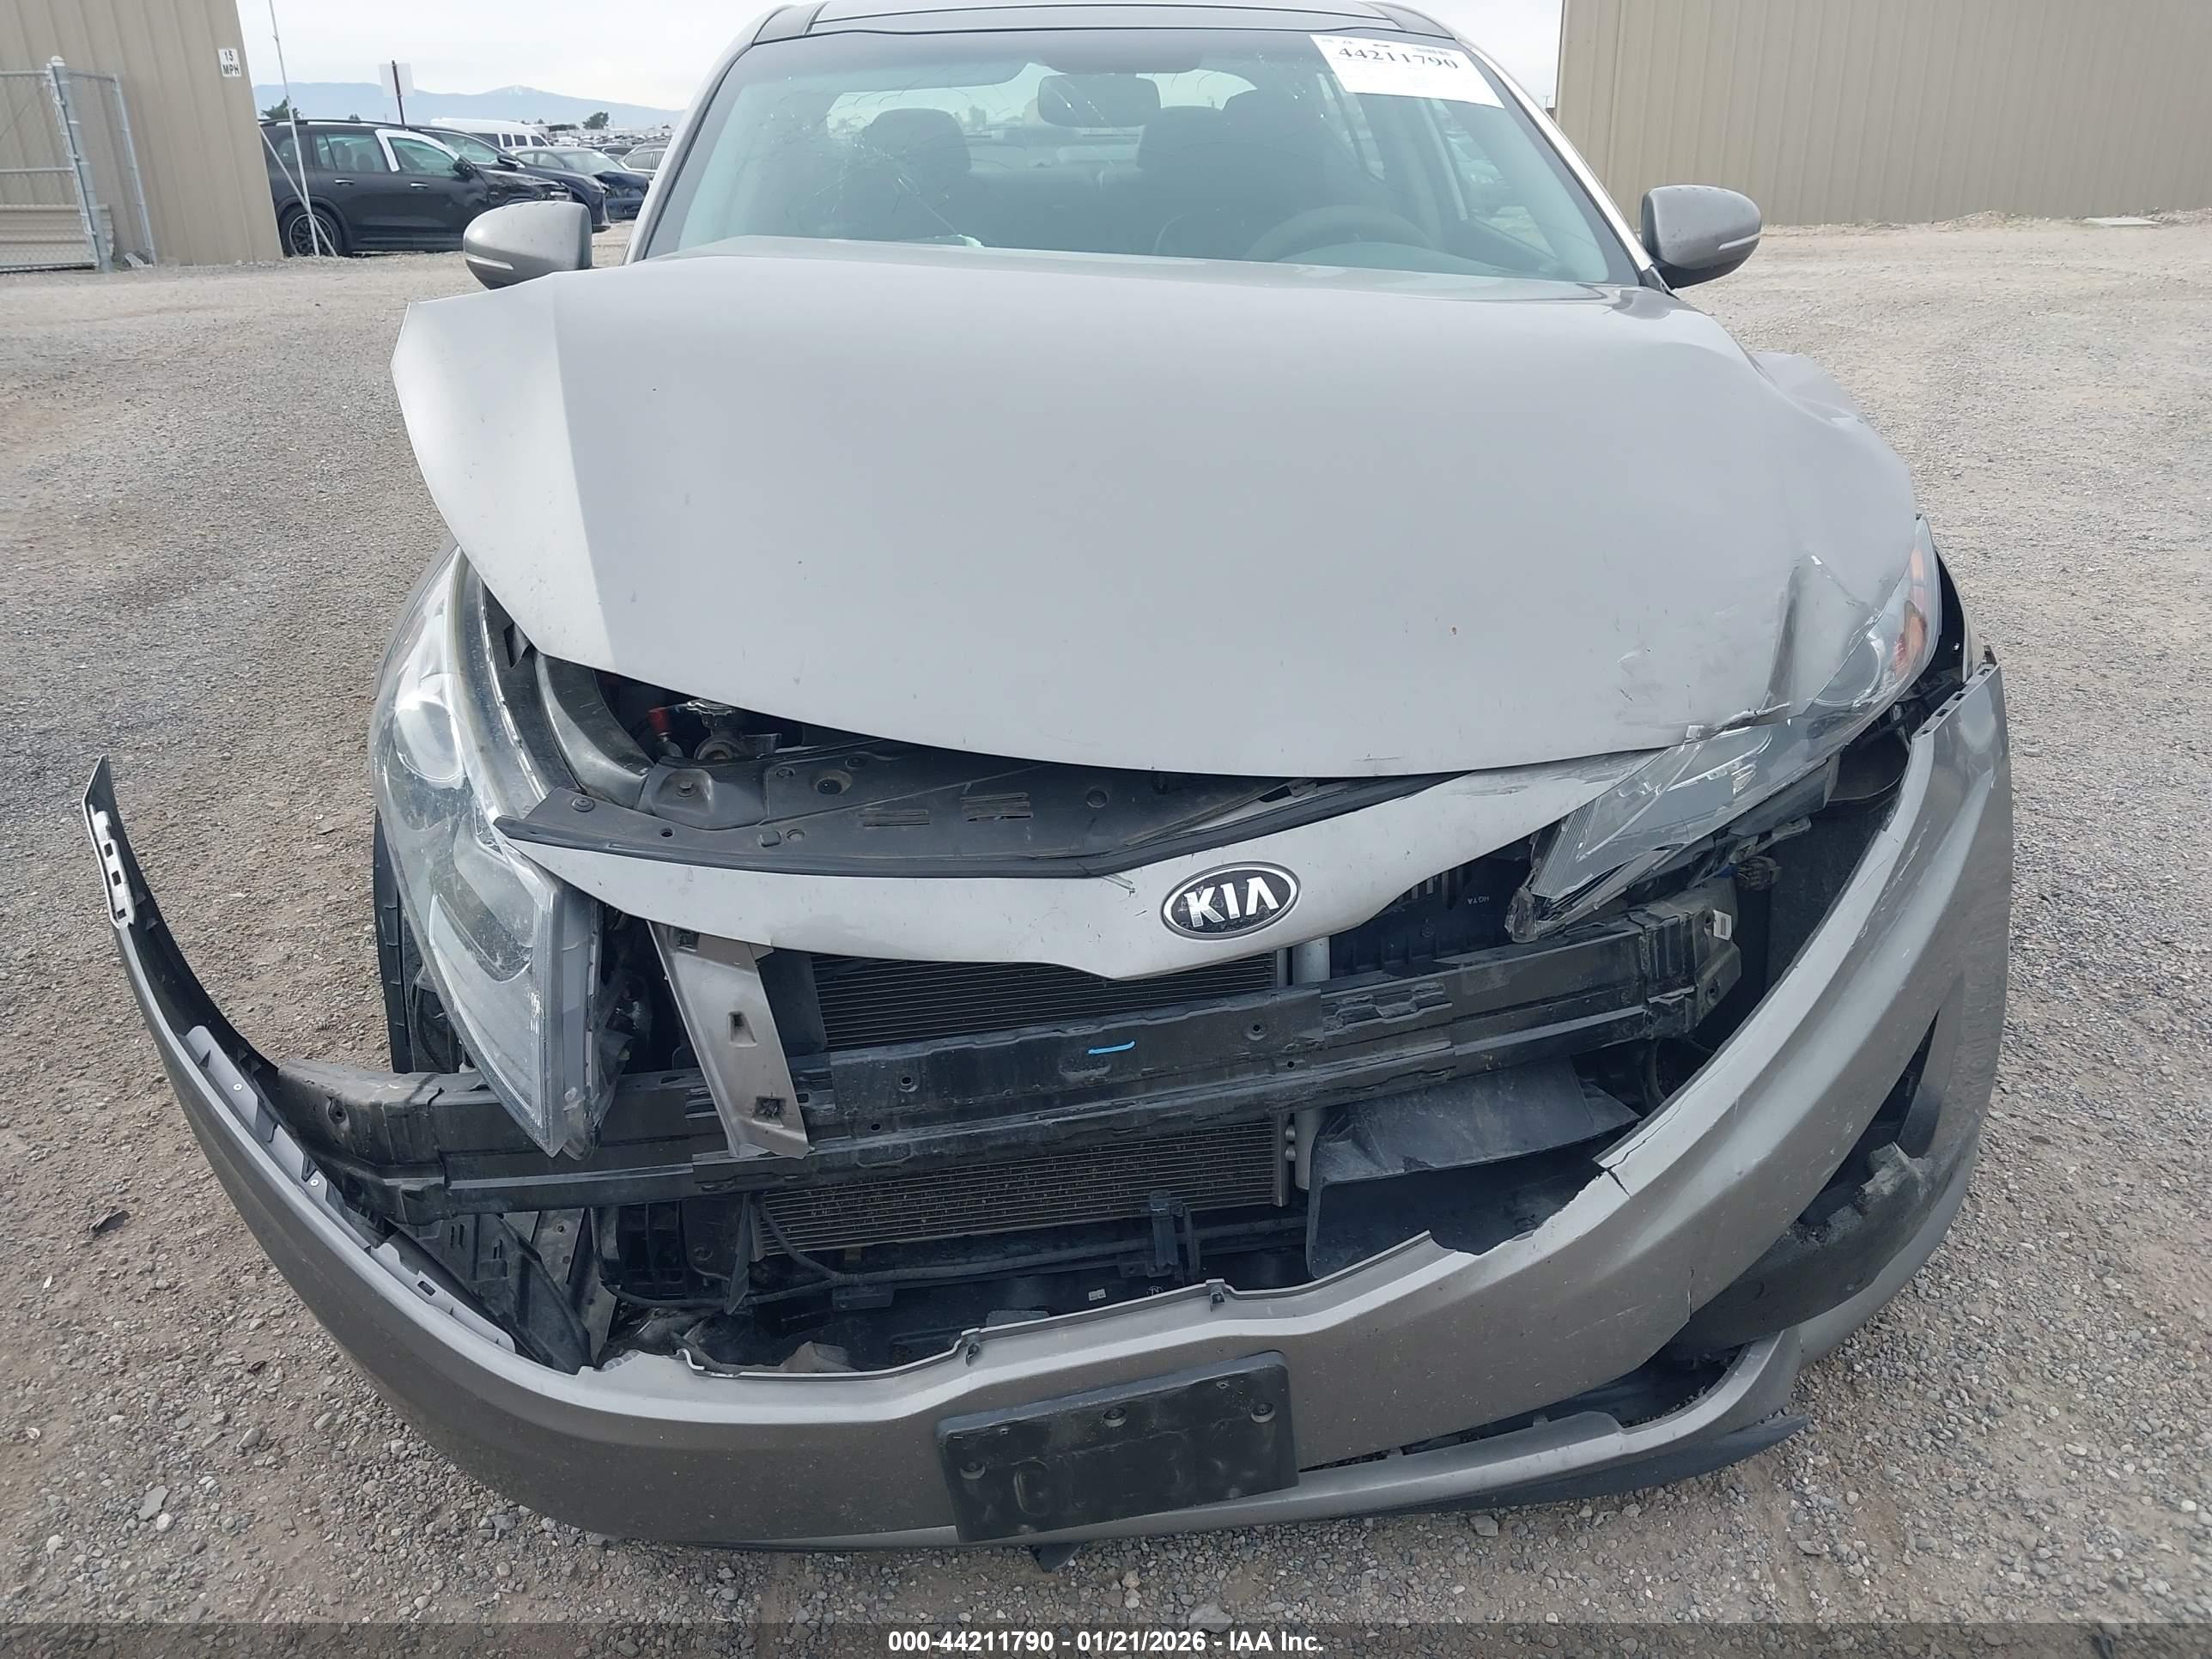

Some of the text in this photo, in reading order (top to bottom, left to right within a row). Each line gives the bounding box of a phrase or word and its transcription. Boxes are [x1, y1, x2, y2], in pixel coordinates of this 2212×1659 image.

[225, 50, 234, 62] 15
[1339, 47, 1459, 70] 44211790
[222, 64, 240, 76] MPH
[1184, 876, 1279, 927] KIA
